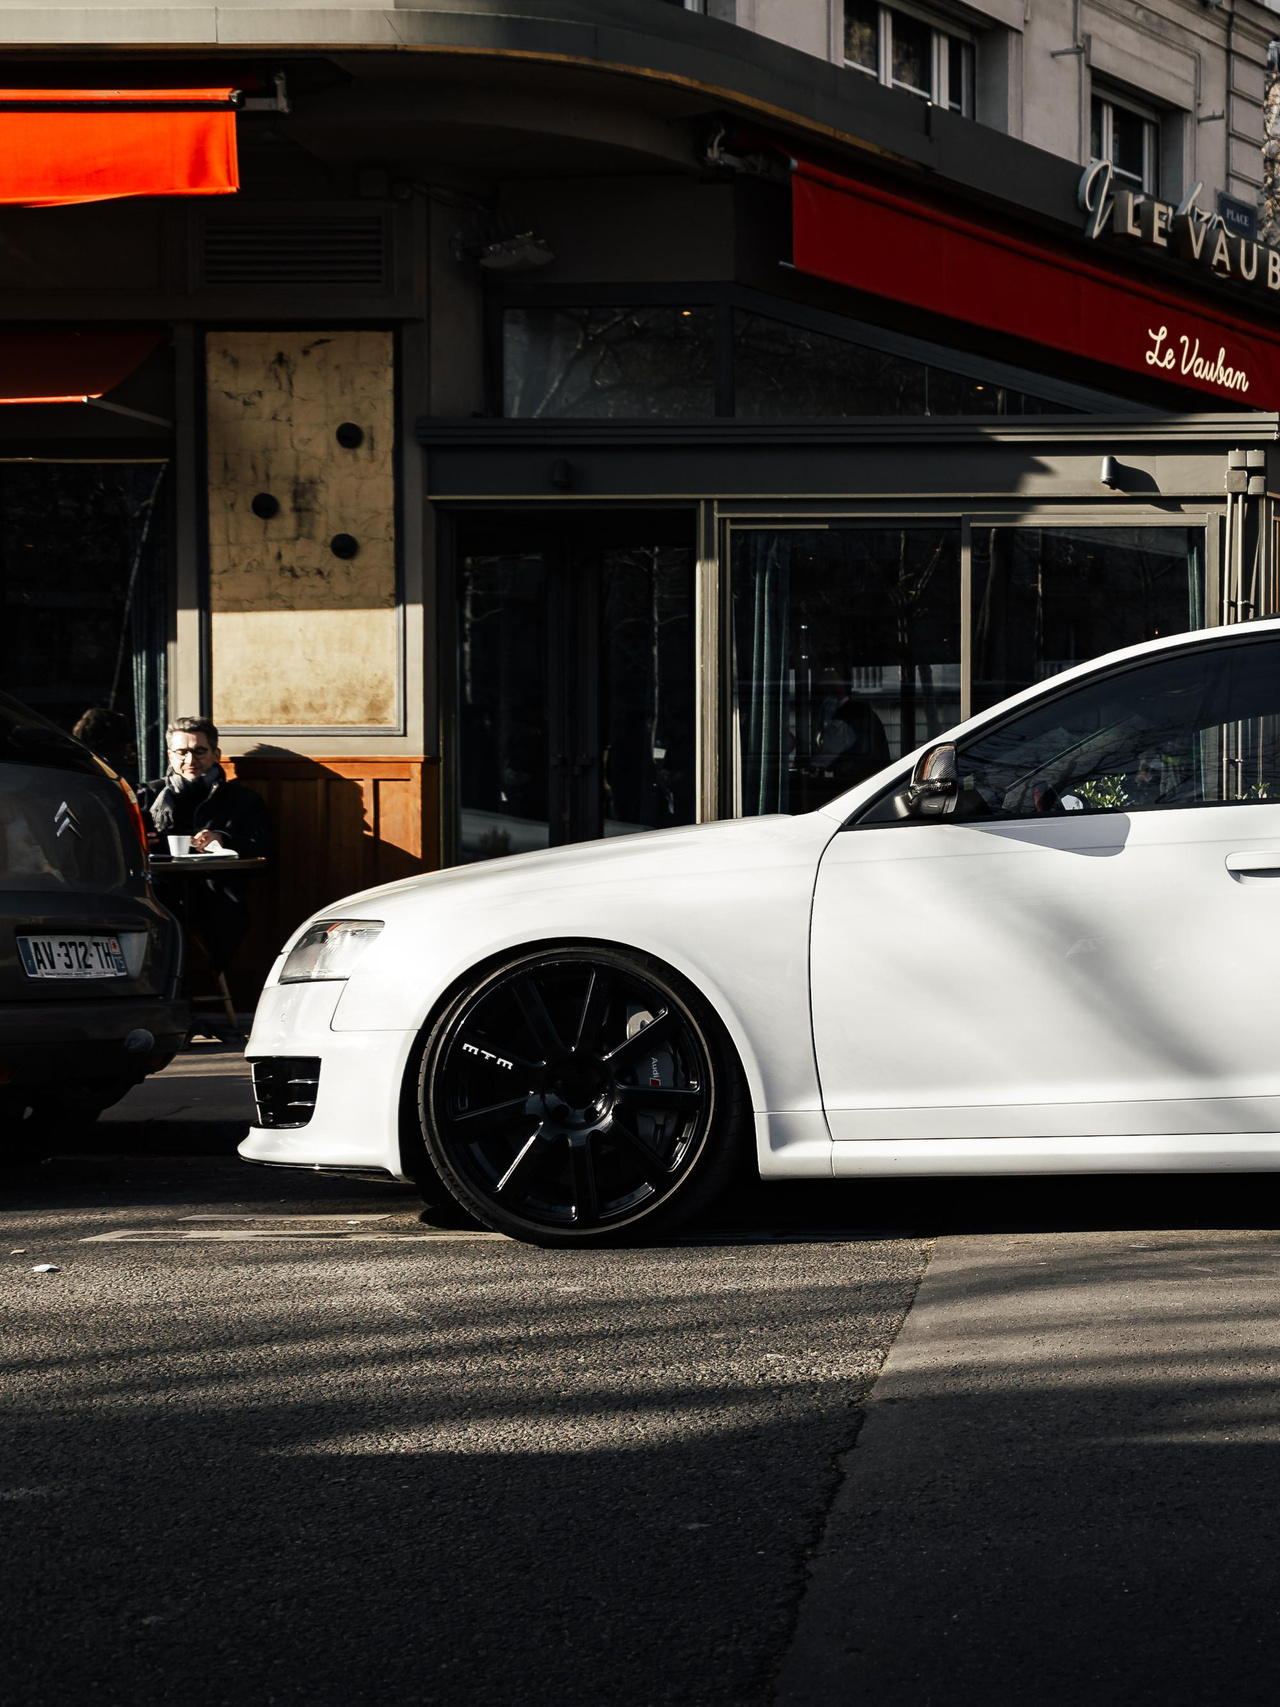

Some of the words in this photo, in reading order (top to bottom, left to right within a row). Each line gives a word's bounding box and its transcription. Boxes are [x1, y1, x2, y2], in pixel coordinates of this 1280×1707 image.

[1127, 190, 1168, 248] LE
[1226, 208, 1250, 227] PLACE
[1145, 326, 1176, 369] Le
[1179, 335, 1250, 392] Vauban
[651, 1057, 660, 1078] Audi
